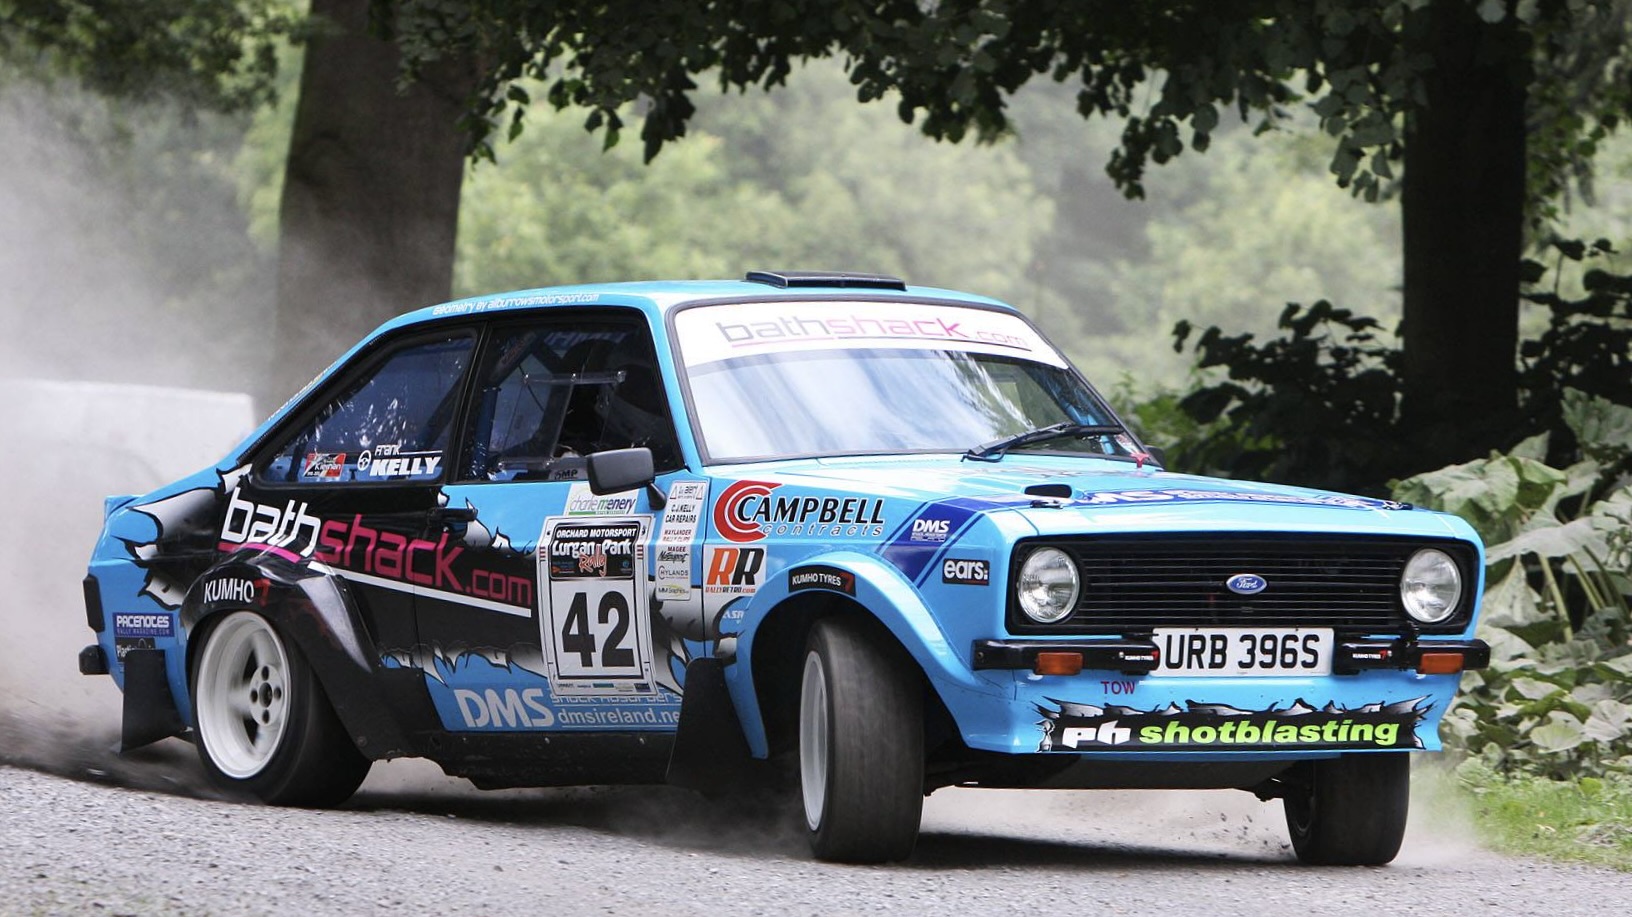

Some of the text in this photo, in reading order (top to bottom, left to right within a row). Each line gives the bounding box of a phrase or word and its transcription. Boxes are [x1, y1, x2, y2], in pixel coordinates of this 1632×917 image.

[716, 315, 1030, 347] bathshack.com
[375, 444, 402, 456] Frank
[370, 456, 441, 476] KELLY
[736, 496, 886, 525] CAMPBELL
[556, 528, 637, 539] ORCHARD MOTORSPORT
[762, 524, 882, 538] contracts
[912, 519, 950, 533] DMS
[220, 487, 532, 605] bathshack.com
[552, 539, 632, 559] Lurgan Park
[706, 547, 765, 586] RR
[204, 578, 254, 604] KUMHO
[792, 573, 842, 586] KUMHO TYRES
[1235, 577, 1259, 589] Ford
[561, 591, 636, 668] 42
[1165, 633, 1322, 670] URB 396S
[1101, 681, 1136, 695] TOW
[454, 688, 555, 728] DMS
[1139, 718, 1399, 747] shotblasting
